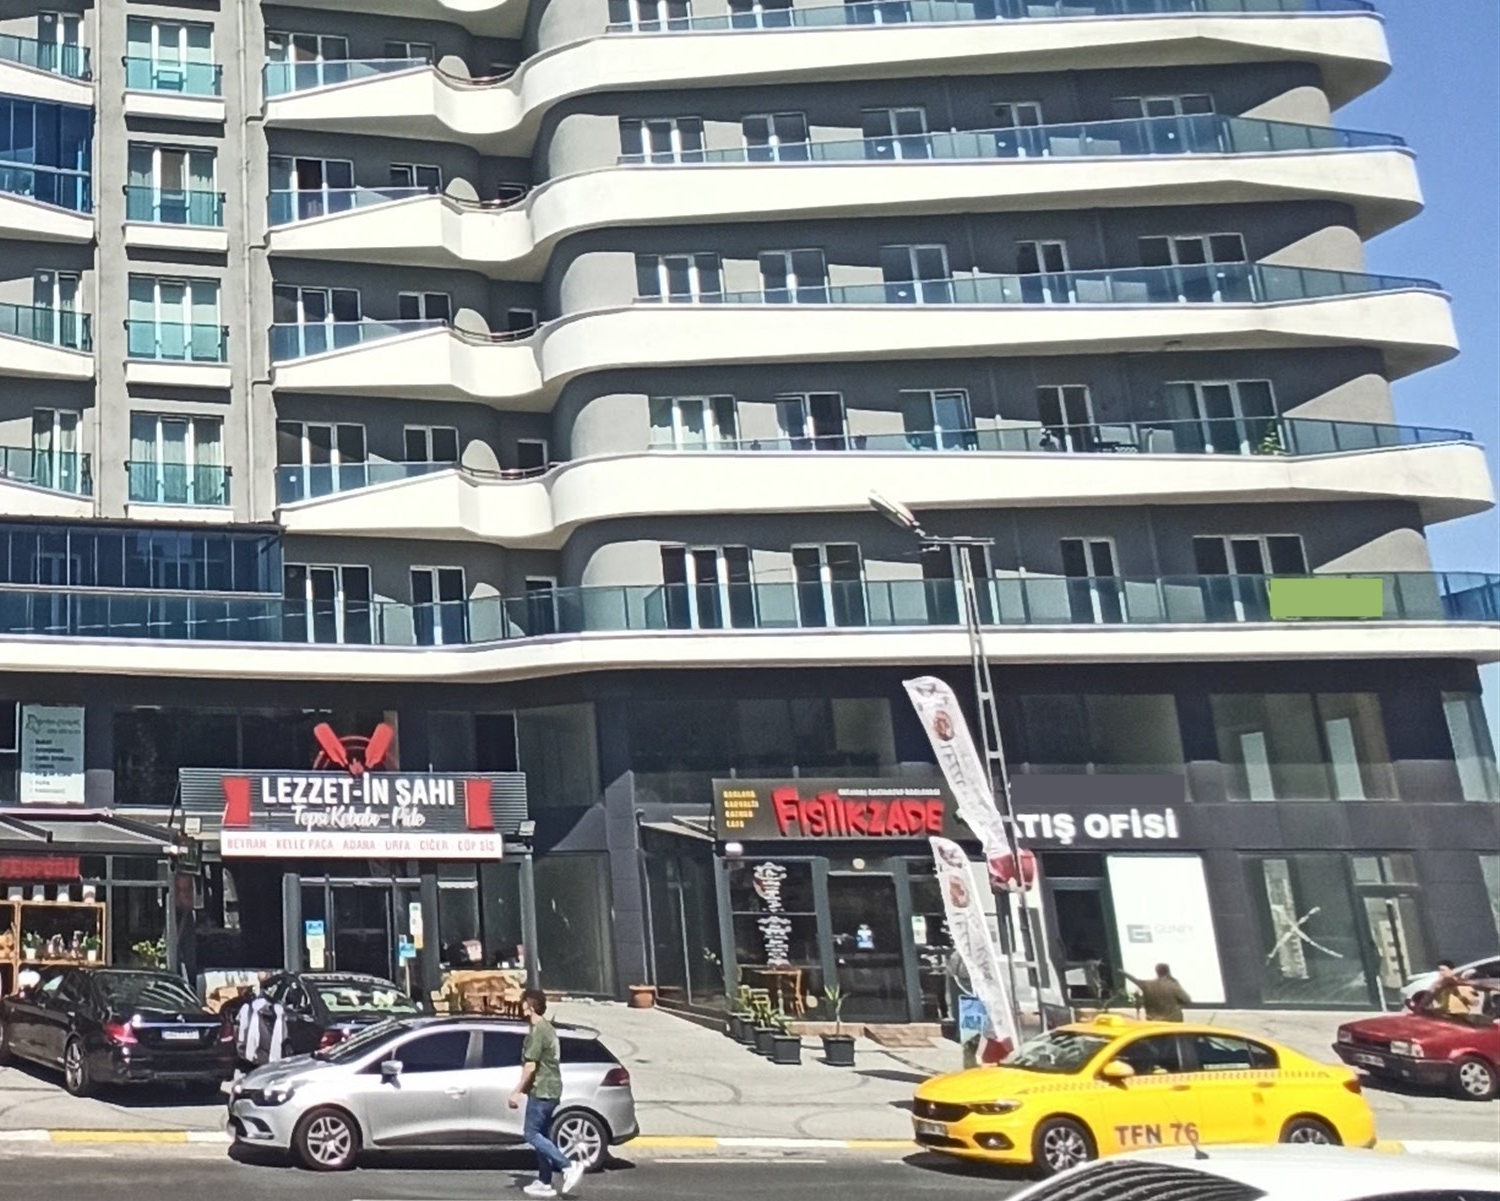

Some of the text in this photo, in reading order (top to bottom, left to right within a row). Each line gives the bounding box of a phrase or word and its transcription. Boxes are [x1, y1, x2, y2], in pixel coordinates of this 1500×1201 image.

[1015, 808, 1180, 845] TIŞ OFİSİ
[1114, 1121, 1199, 1146] TFN 76
